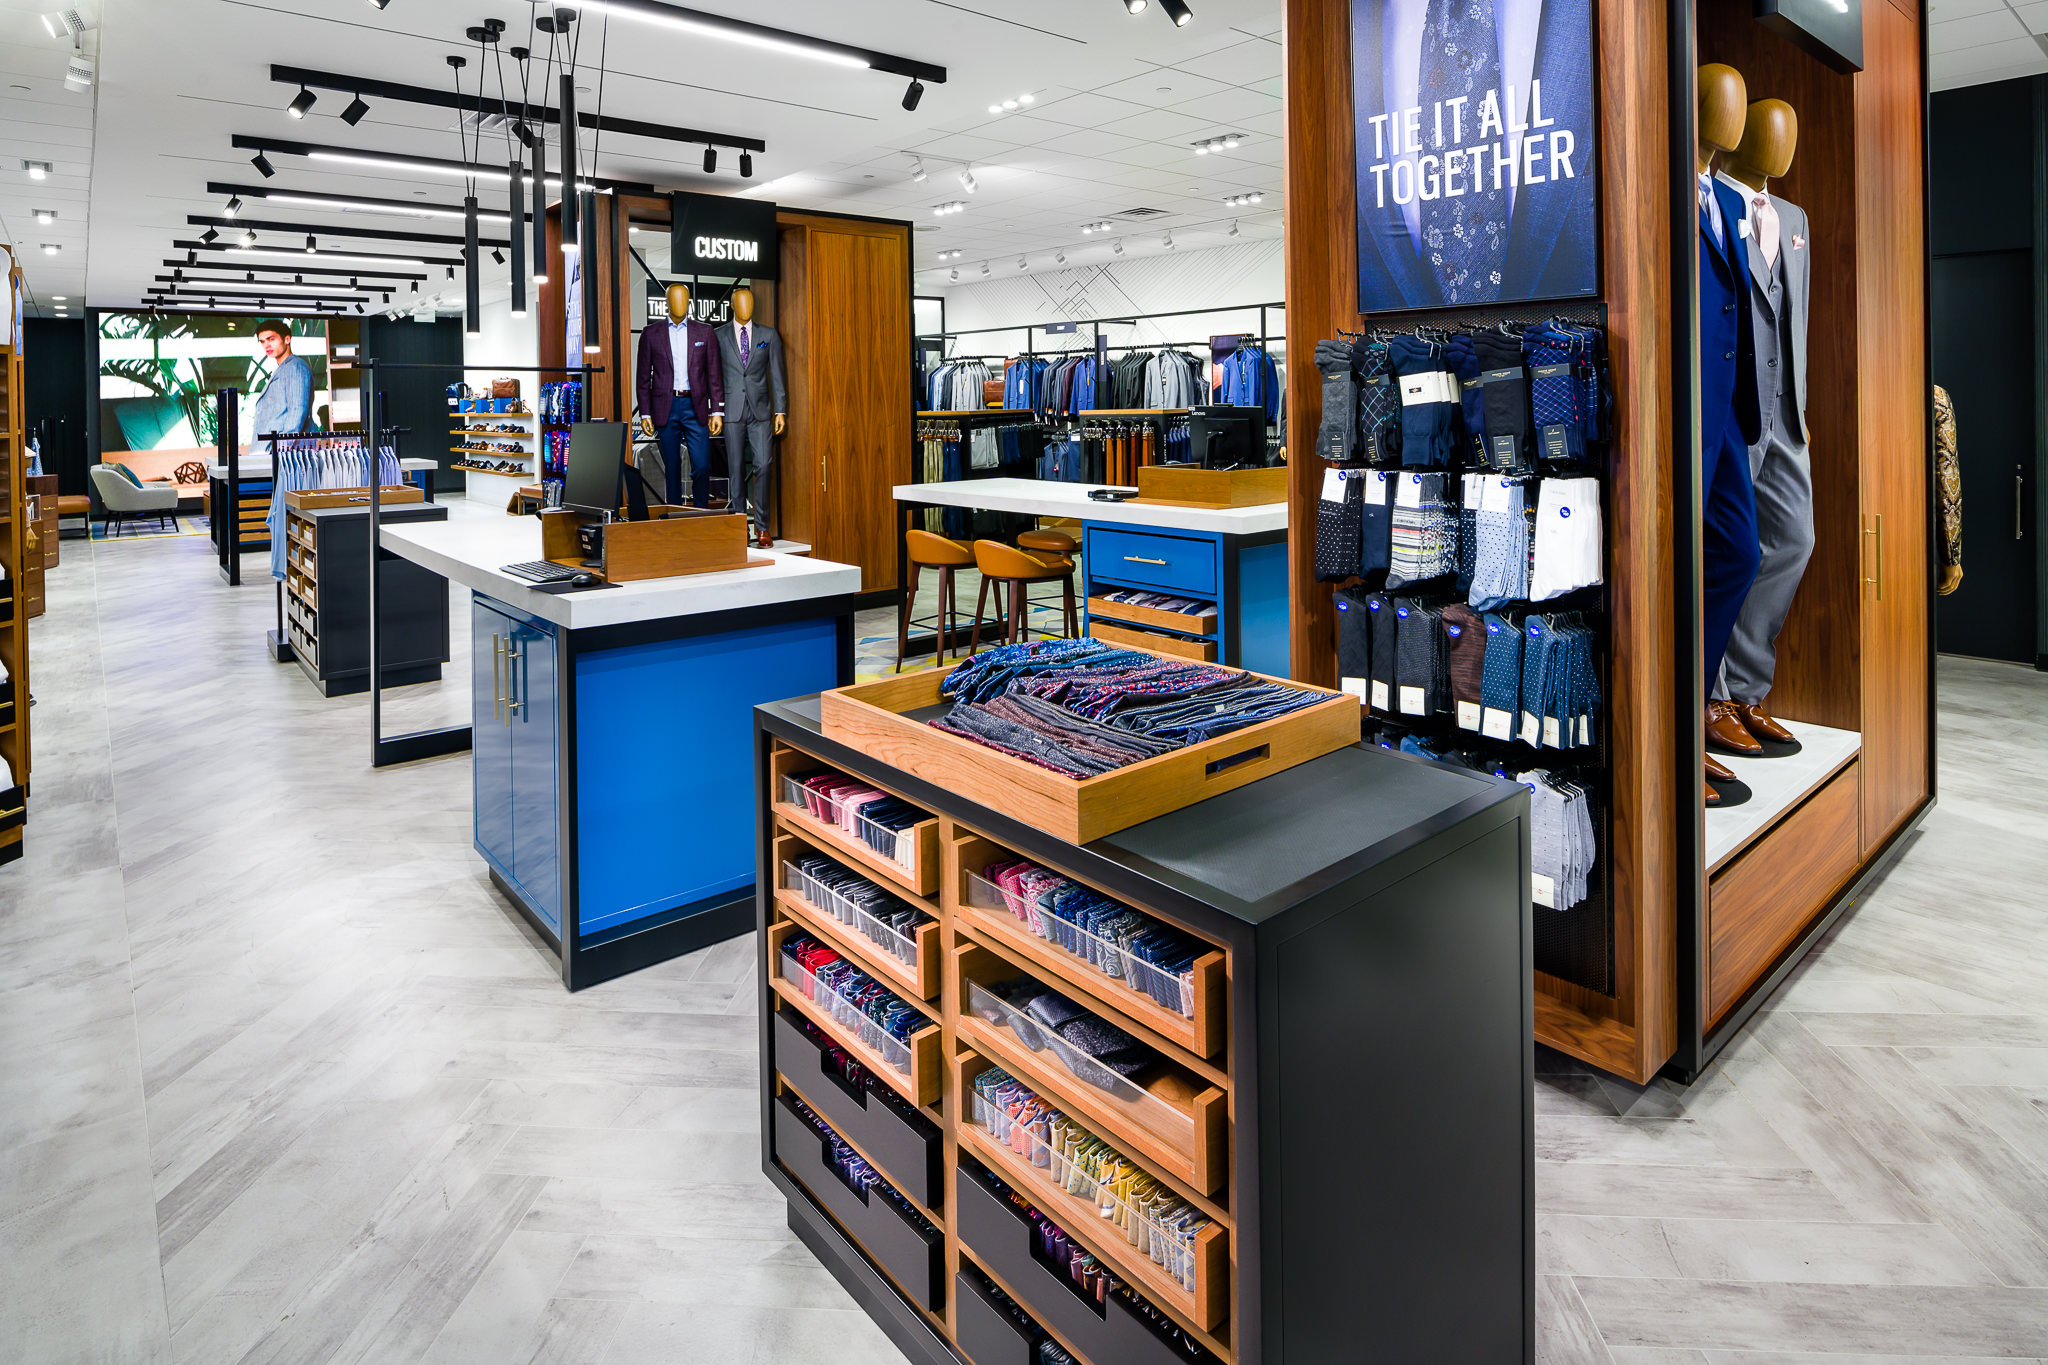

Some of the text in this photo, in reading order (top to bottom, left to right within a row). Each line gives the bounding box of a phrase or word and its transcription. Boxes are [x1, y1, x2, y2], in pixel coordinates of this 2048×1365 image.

[1368, 79, 1554, 159] TIE IT ALL
[1369, 129, 1575, 208] TOGETHER
[694, 236, 758, 261] CUSTOM
[648, 298, 730, 322] THE AULT
